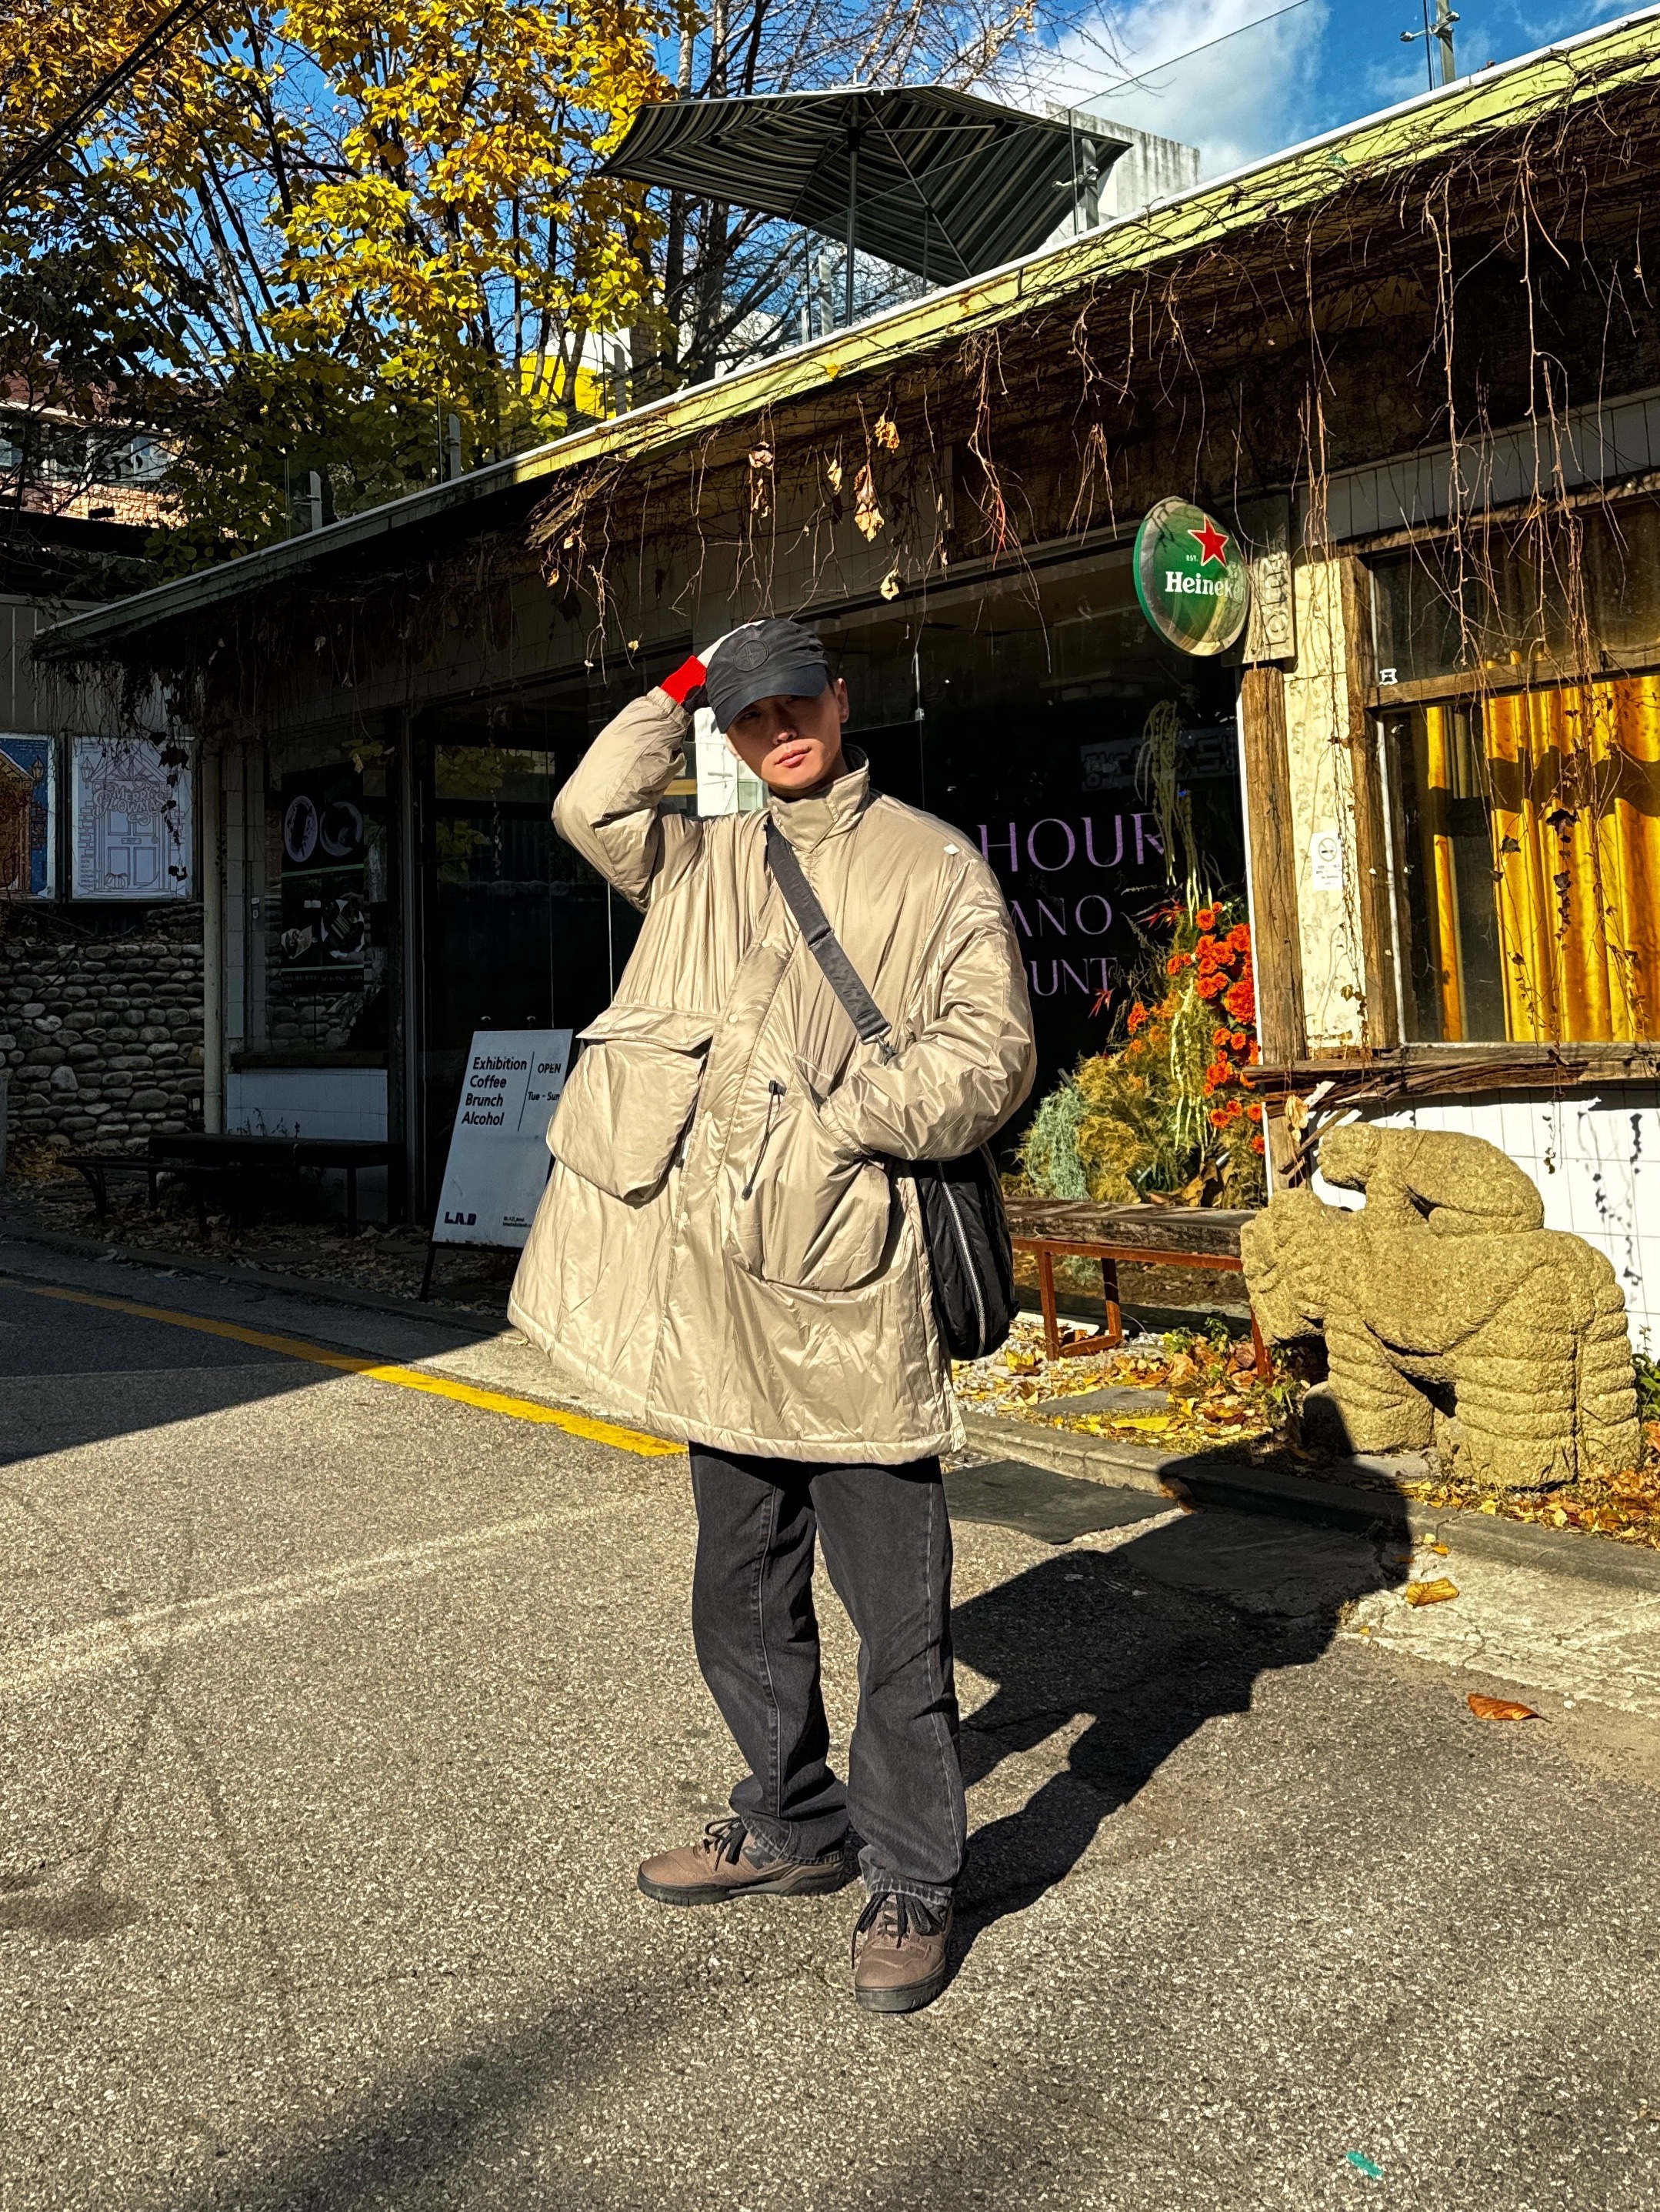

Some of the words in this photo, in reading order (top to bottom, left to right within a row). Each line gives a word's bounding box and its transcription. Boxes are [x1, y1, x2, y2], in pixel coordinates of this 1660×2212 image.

[472, 1056, 528, 1071] Exhibition
[538, 1063, 562, 1074] OPEN
[470, 1075, 507, 1089] Coffee
[465, 1093, 504, 1107] Brunch
[528, 1091, 540, 1101] Tue
[461, 1111, 505, 1126] Alcohol
